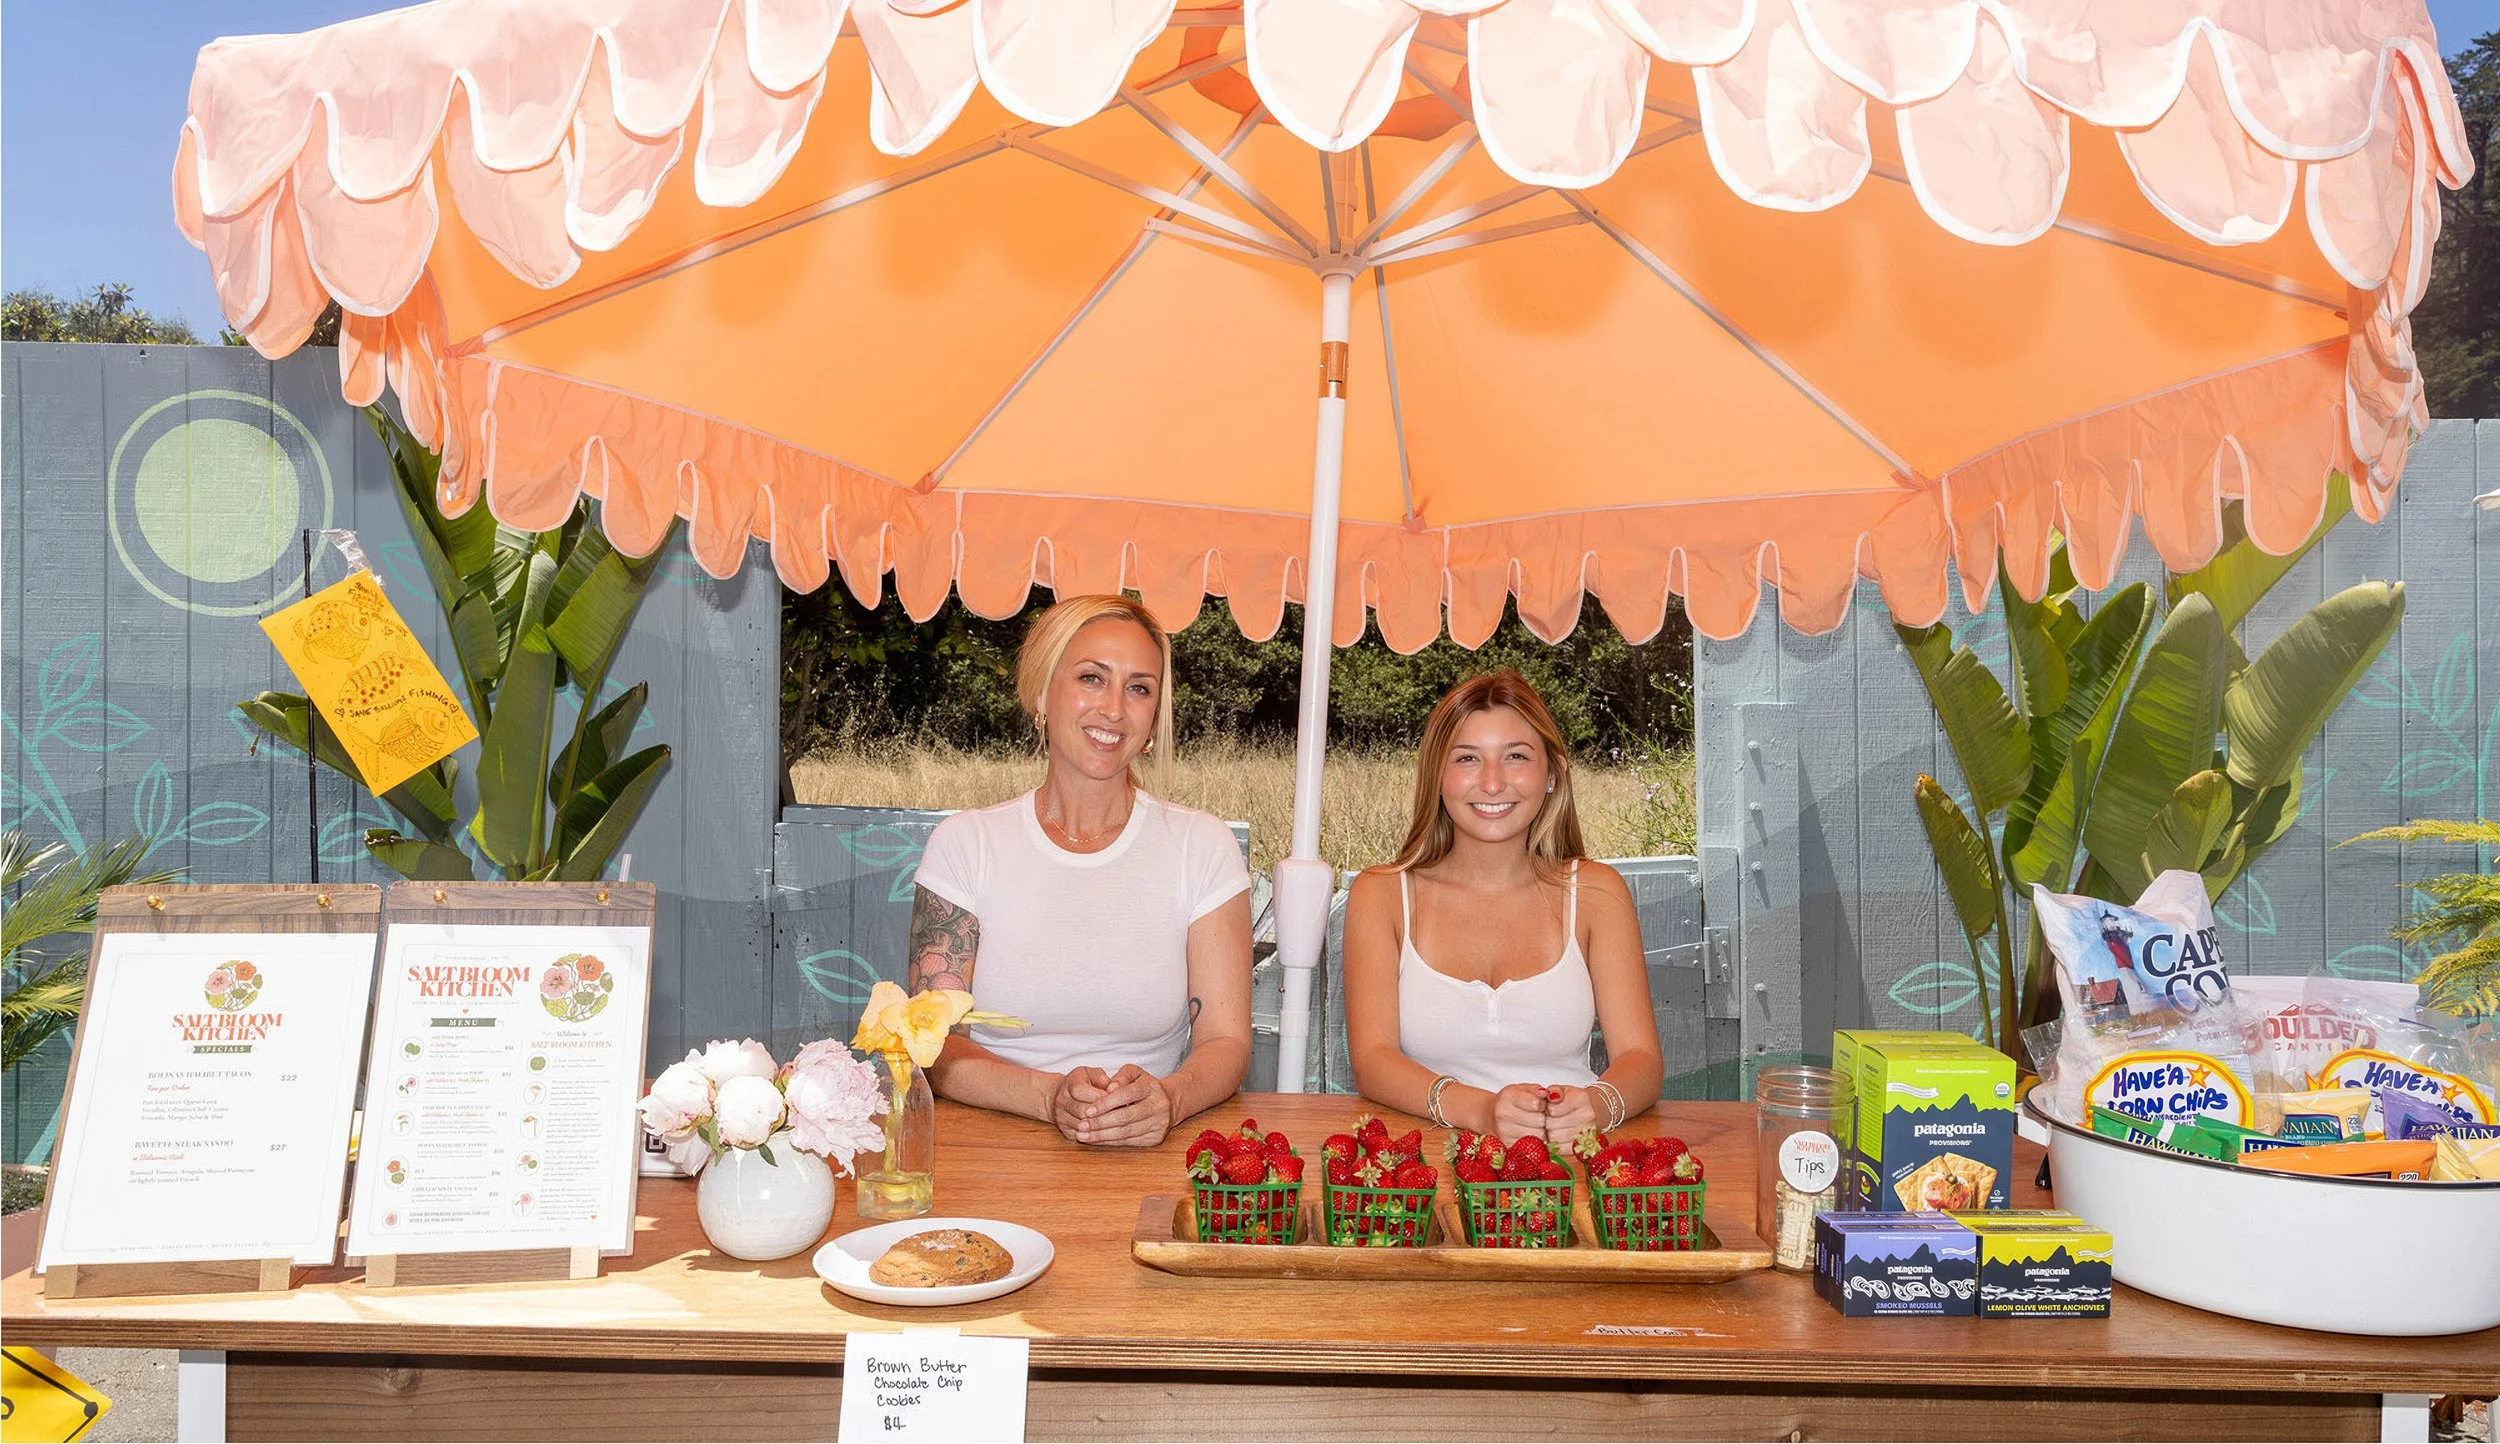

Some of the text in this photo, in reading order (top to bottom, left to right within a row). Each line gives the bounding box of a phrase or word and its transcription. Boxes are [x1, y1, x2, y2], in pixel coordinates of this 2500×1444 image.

[408, 687, 449, 706] FISHING
[420, 981, 515, 997] KITCHEN
[448, 1019, 479, 1027] MENU
[182, 1027, 268, 1041] KITCHEN
[280, 1074, 298, 1082] $22
[2107, 1097, 2164, 1115] ORN
[1914, 1122, 1986, 1138] patagonia
[1928, 1138, 1973, 1146] PROVISIONS
[1794, 1157, 1826, 1180] Tips
[1887, 1265, 1933, 1275] patagonia
[2024, 1267, 2070, 1277] patagonia
[867, 1357, 967, 1374] Brown Butter
[874, 1375, 964, 1392] Chocolate Chip
[876, 1394, 921, 1408] Cookies
[884, 1415, 907, 1431] $4
